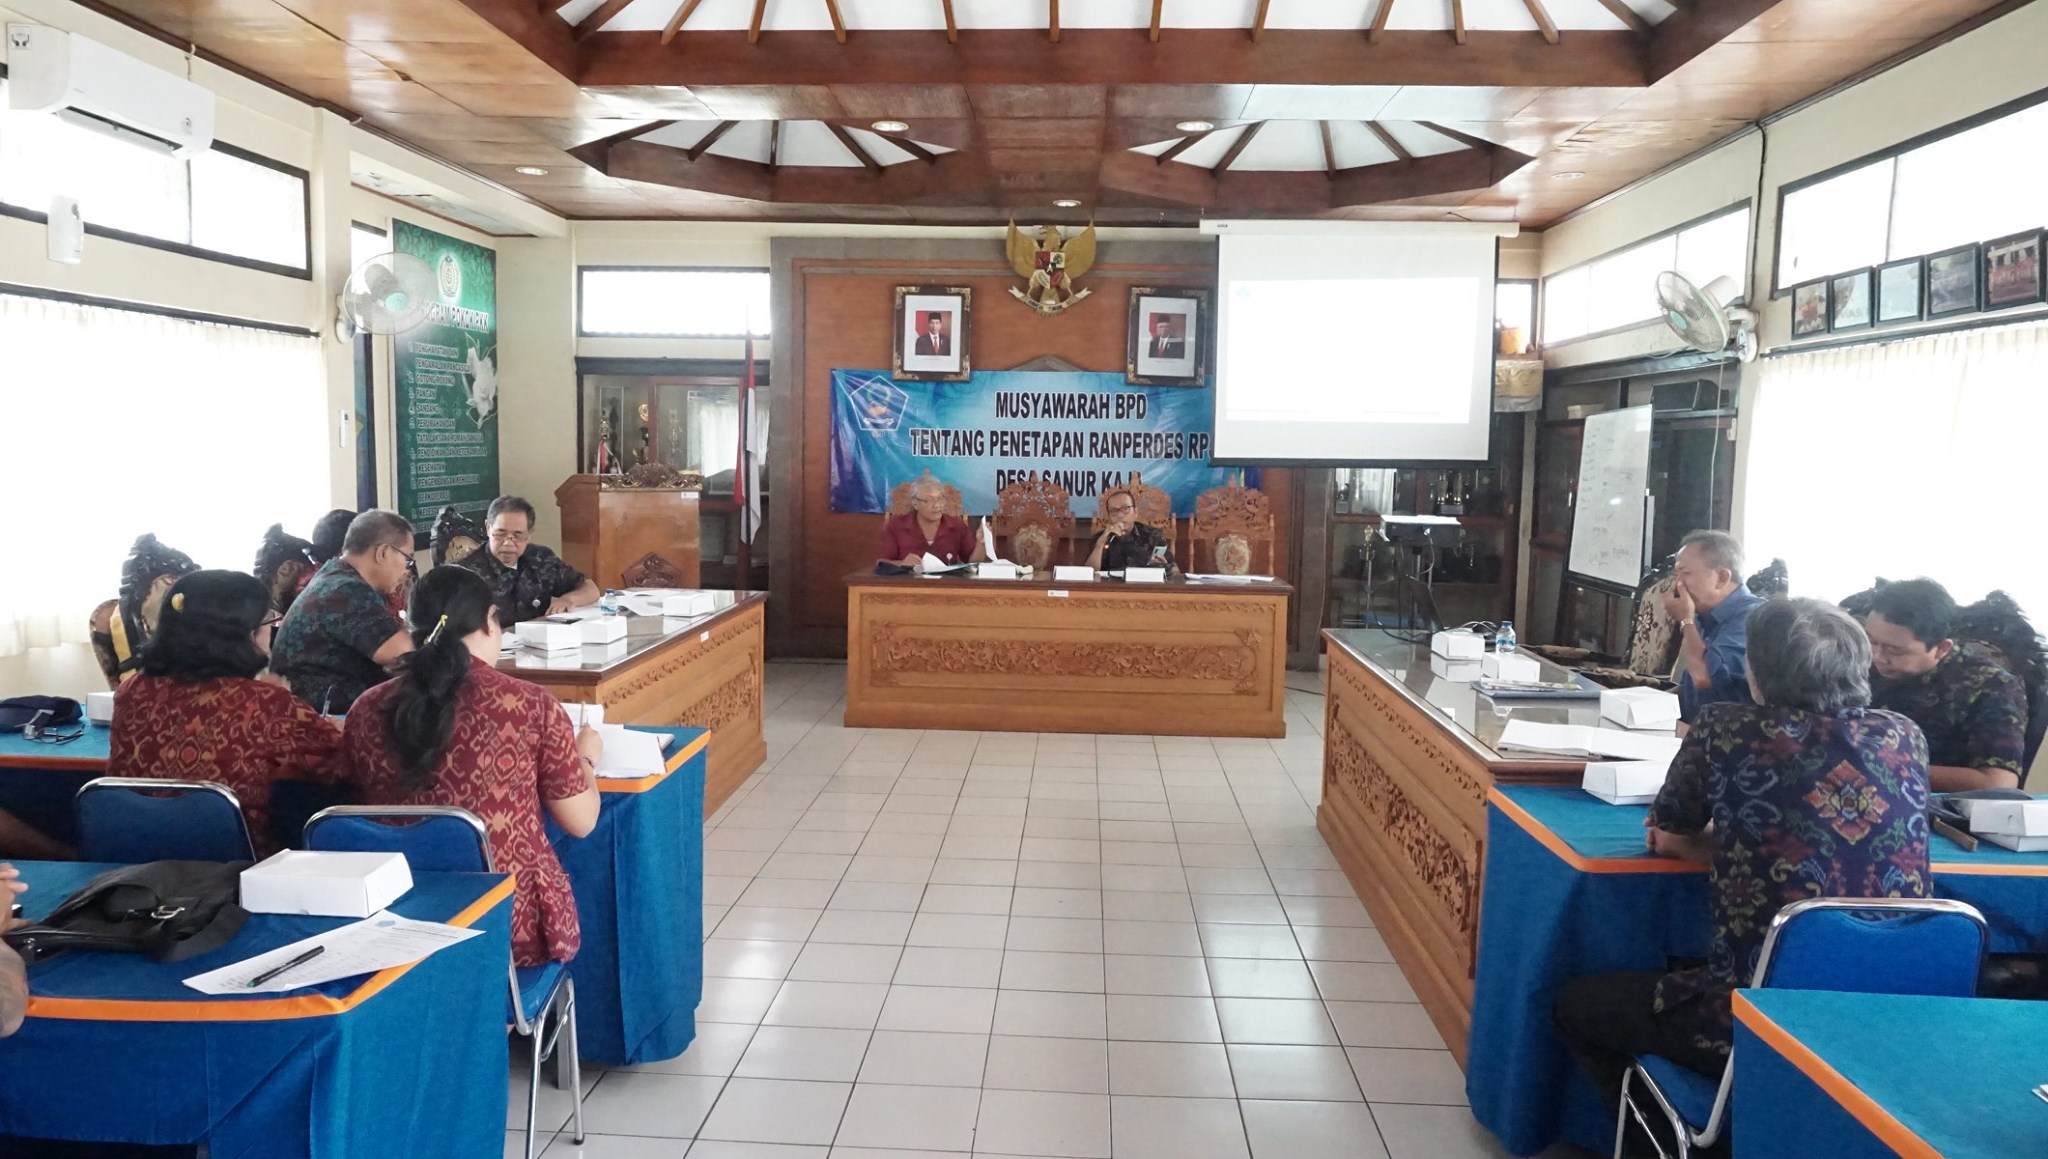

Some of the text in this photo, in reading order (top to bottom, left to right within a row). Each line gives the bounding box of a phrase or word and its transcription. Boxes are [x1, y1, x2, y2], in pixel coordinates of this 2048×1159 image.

[995, 391, 1147, 420] MUSYAWARAH BPD
[910, 428, 1213, 460] TENTANG PENETAPAN RANPERDES RP
[996, 469, 1034, 495] DES
[1042, 469, 1097, 497] SANUR
